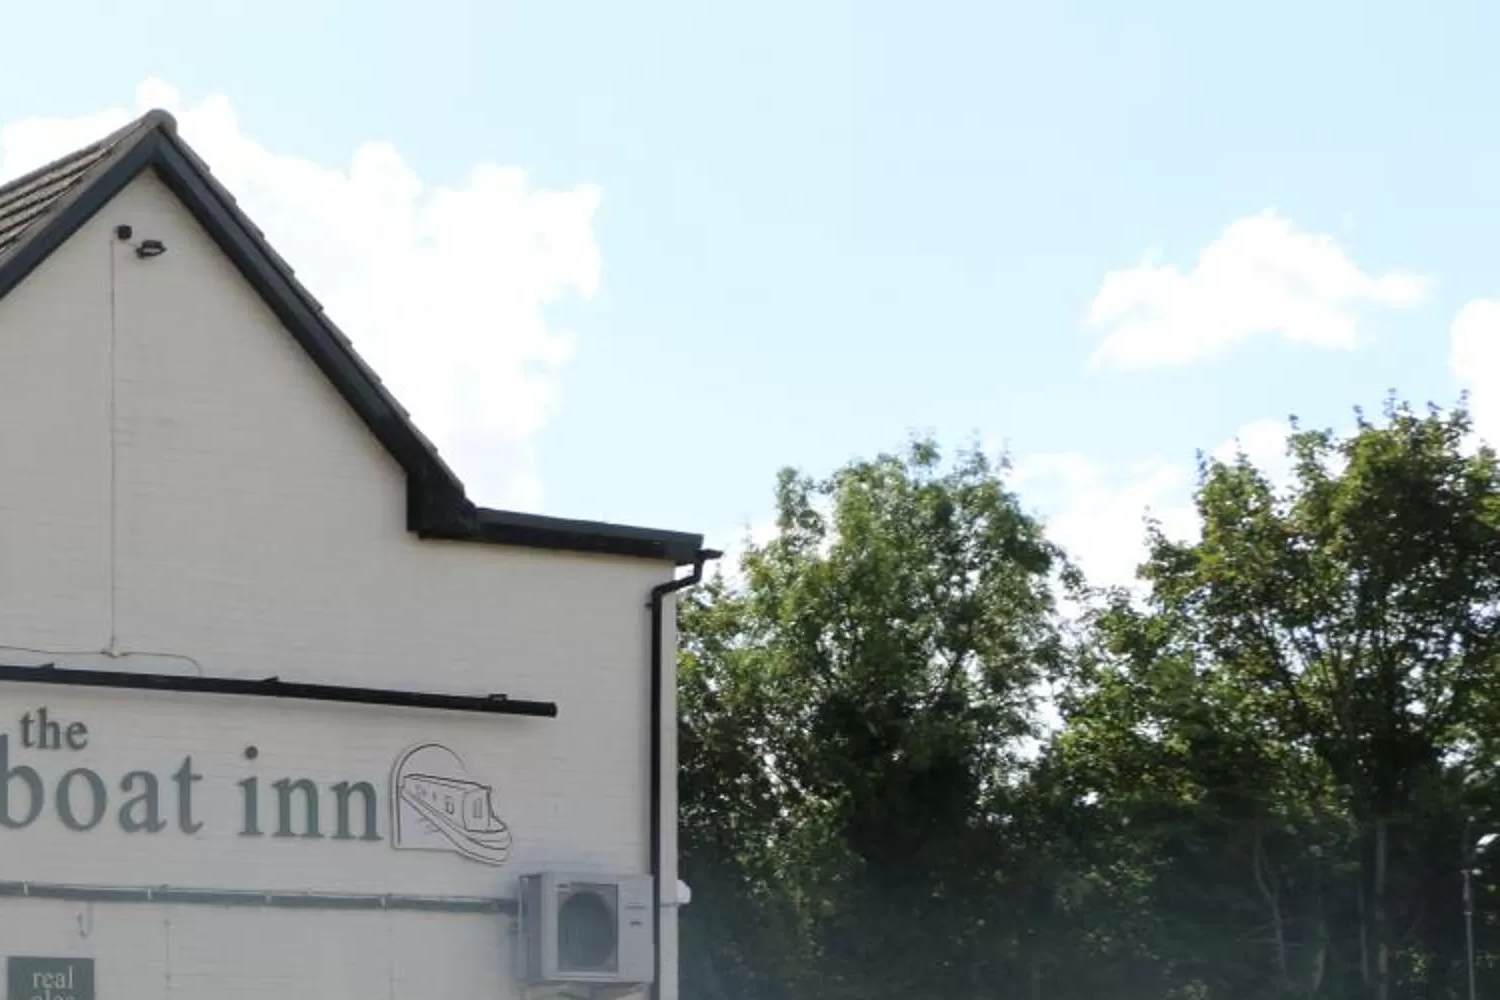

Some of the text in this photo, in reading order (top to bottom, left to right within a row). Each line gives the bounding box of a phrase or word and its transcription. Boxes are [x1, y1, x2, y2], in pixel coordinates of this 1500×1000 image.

[19, 706, 88, 749] the
[236, 745, 384, 841] inn
[32, 965, 74, 989] real
